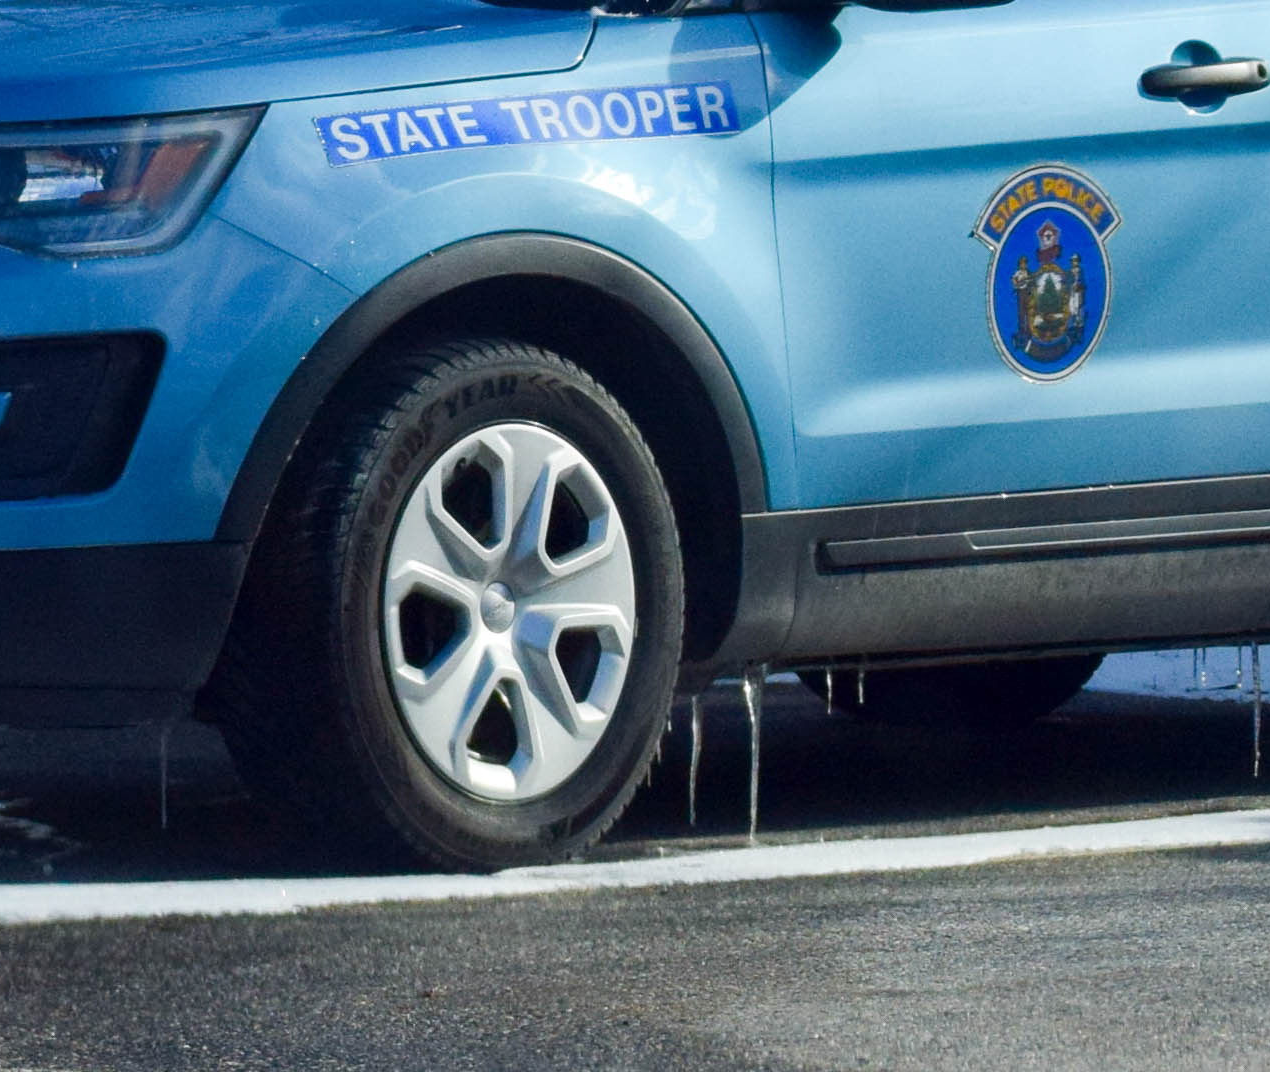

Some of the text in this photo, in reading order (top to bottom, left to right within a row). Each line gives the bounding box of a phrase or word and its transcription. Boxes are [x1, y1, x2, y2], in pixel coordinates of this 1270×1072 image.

[329, 84, 729, 161] STATE TROOPER
[989, 177, 1106, 233] STATE POLICE
